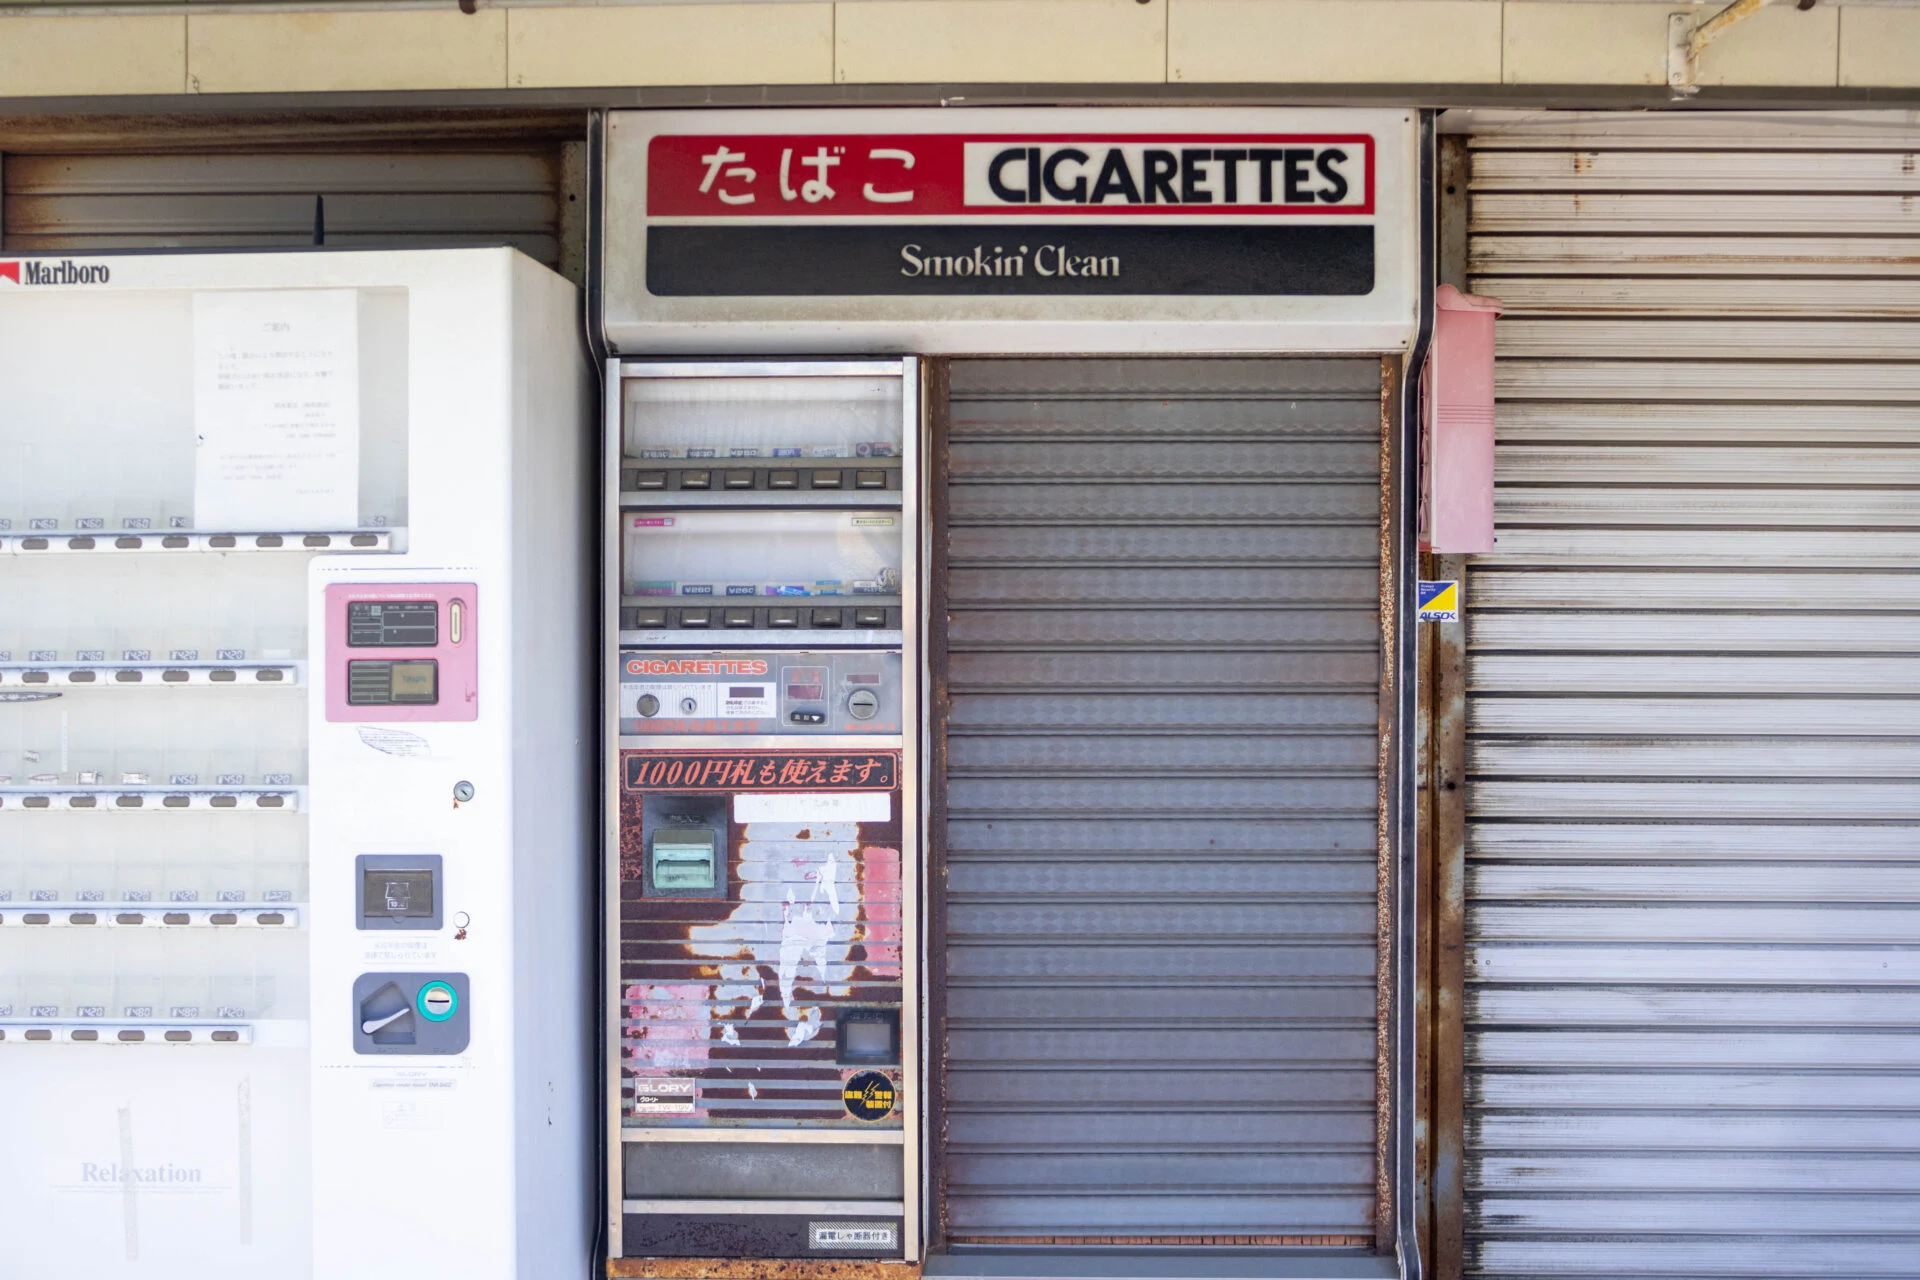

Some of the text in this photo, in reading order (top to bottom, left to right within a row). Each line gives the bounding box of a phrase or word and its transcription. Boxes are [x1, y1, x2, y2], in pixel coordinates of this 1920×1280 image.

[698, 145, 915, 205] たばこ
[987, 148, 1348, 205] CIGARETTES
[25, 260, 110, 285] Marlboro
[900, 244, 1120, 278] Smokin' Clean
[1420, 612, 1456, 620] ALSOK
[626, 660, 768, 675] CIGARETTES
[634, 758, 889, 785] 1000円札も使えます。
[639, 1084, 691, 1093] GLORY
[81, 1162, 203, 1183] Relaxation
[819, 1231, 888, 1240] 漏電しゃ断器付き
